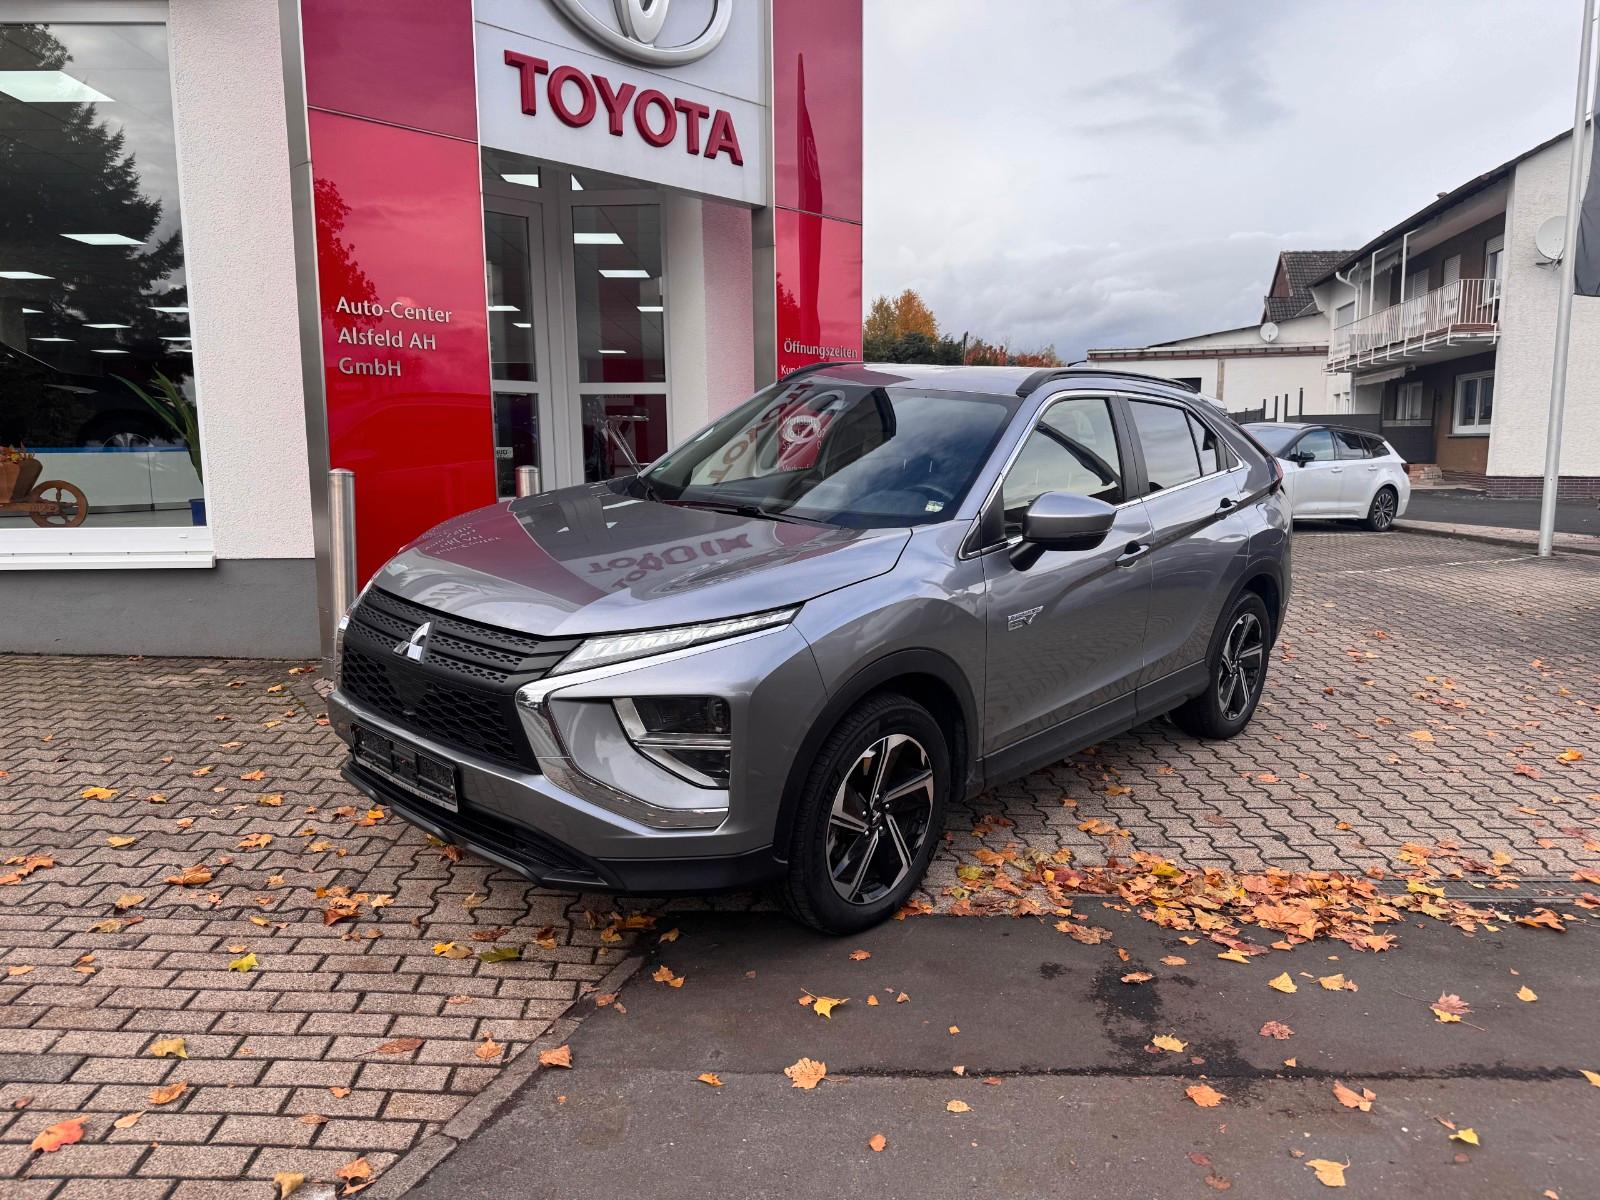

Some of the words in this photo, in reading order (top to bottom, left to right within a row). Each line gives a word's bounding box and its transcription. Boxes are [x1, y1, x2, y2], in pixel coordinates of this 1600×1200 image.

[504, 50, 743, 166] TOYOTA
[336, 296, 452, 323] Auto-Center
[338, 327, 403, 348] Alsfeld
[409, 332, 436, 350] AH
[784, 338, 857, 358] Öffnungszeiten
[338, 357, 402, 377] GmbH
[781, 365, 800, 375] Kun
